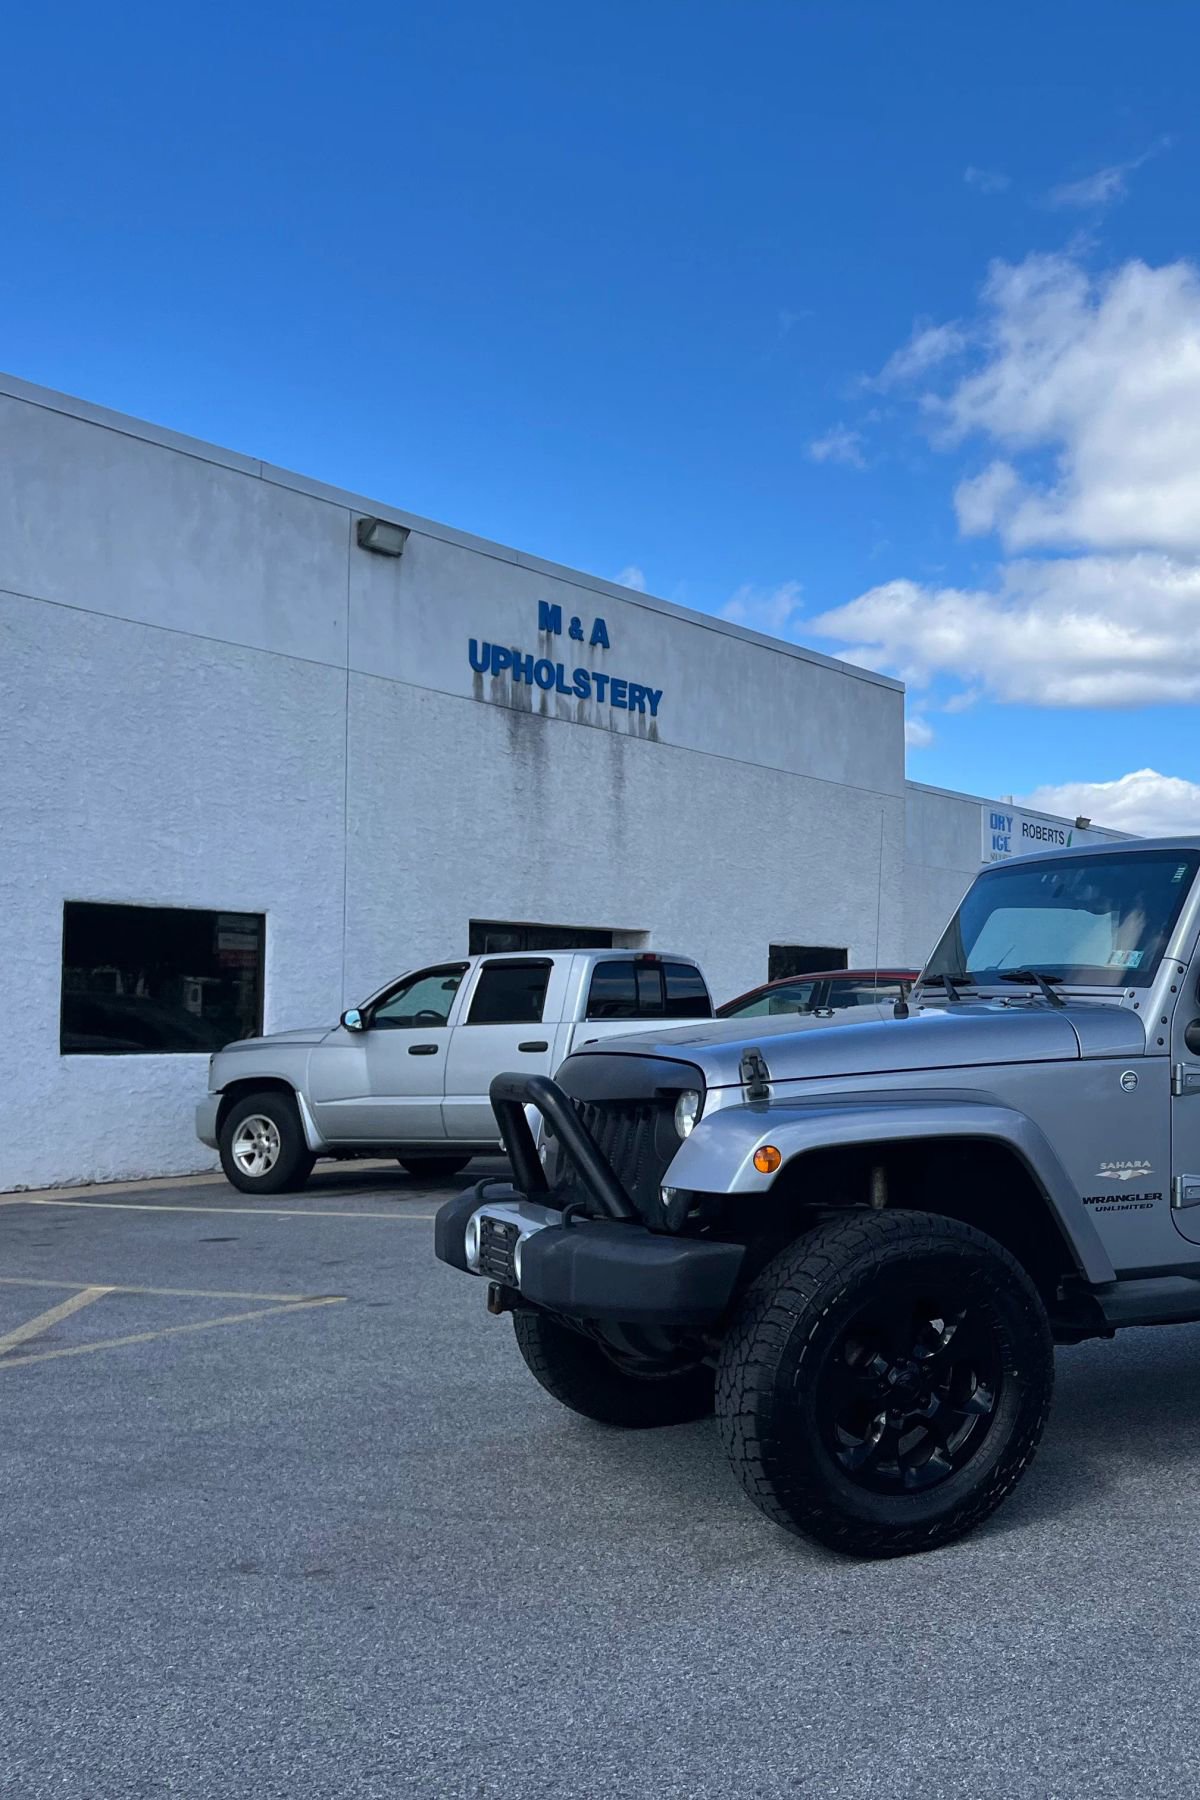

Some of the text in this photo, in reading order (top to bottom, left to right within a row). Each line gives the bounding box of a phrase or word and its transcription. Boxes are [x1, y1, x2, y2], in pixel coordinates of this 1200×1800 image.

[538, 600, 610, 649] M & A
[468, 638, 663, 717] UPHOLSTERY
[990, 812, 1013, 833] DRY
[1022, 822, 1065, 845] ROBERTS
[992, 835, 1011, 852] ICE
[1100, 1160, 1151, 1170] SAHARA
[1082, 1192, 1163, 1204] WRANGLER
[1095, 1203, 1154, 1212] UNLIMITED
